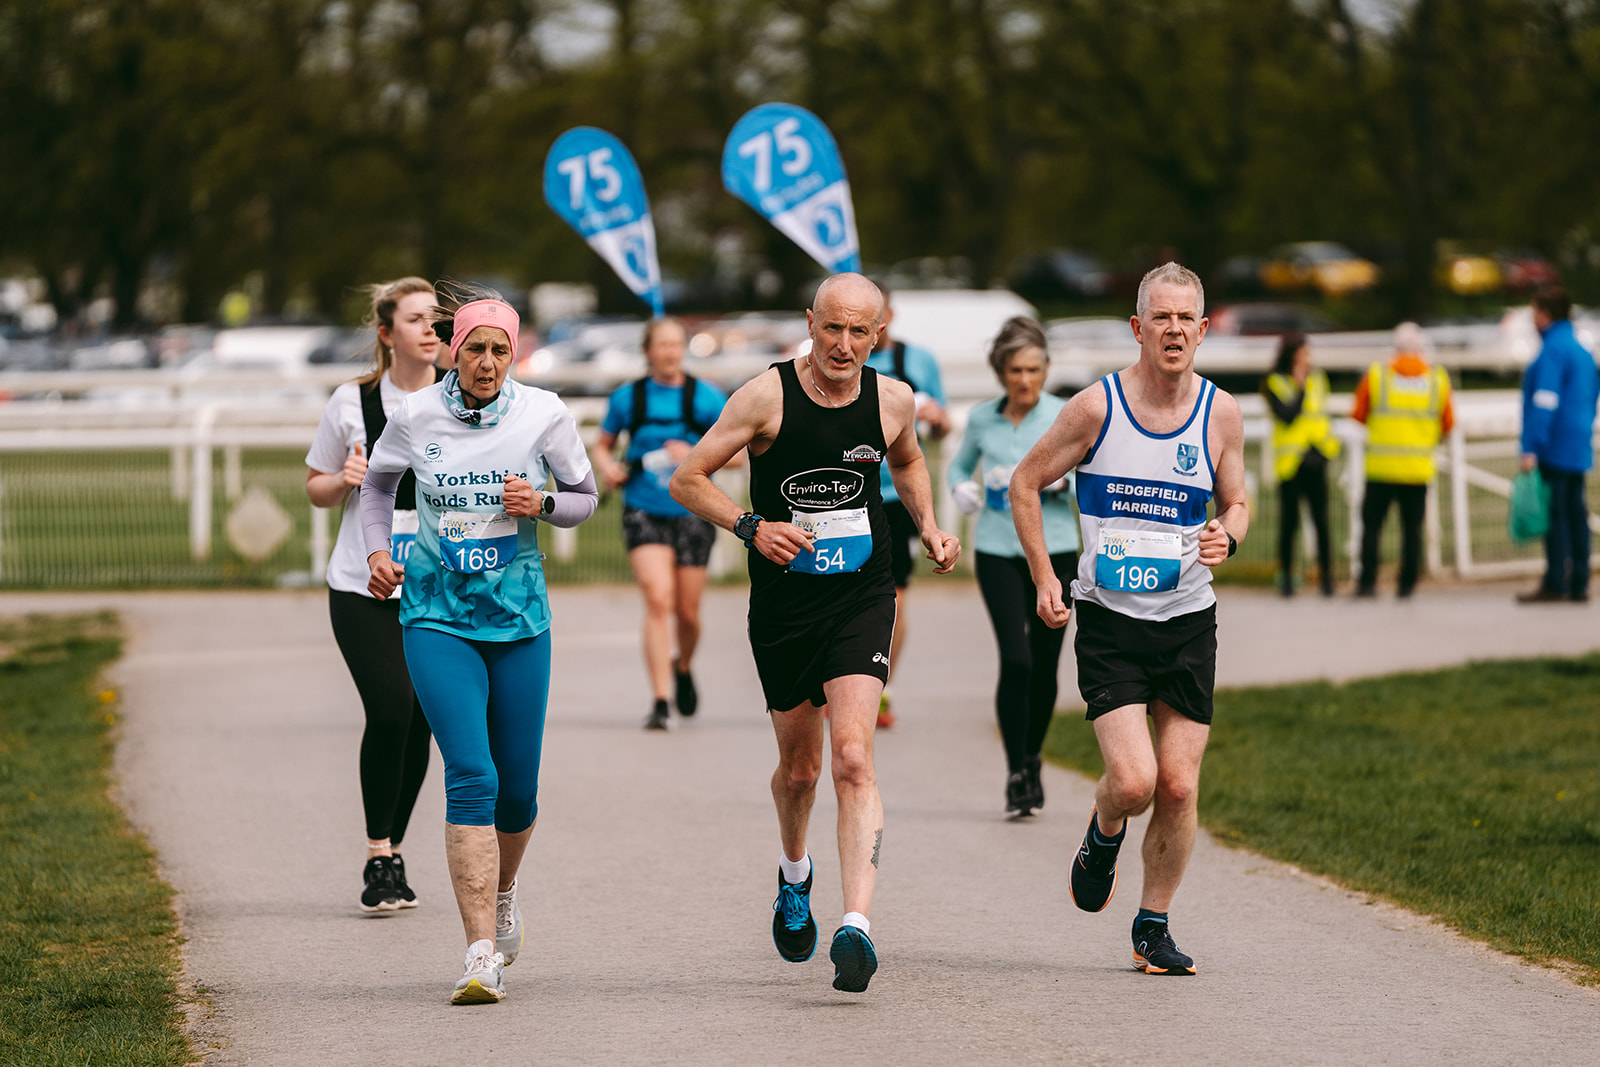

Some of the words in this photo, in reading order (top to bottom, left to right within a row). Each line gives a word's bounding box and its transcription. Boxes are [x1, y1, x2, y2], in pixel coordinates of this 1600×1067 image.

[738, 117, 813, 191] 75
[557, 147, 623, 210] 75
[434, 470, 527, 487] Yorkshie
[1106, 483, 1188, 503] SEDGEFIELD
[1112, 500, 1179, 519] HARRIERS
[443, 527, 464, 538] 10k
[455, 546, 498, 570] 169
[814, 546, 846, 571] 54
[1103, 544, 1126, 556] 10k
[1115, 565, 1159, 590] 196
